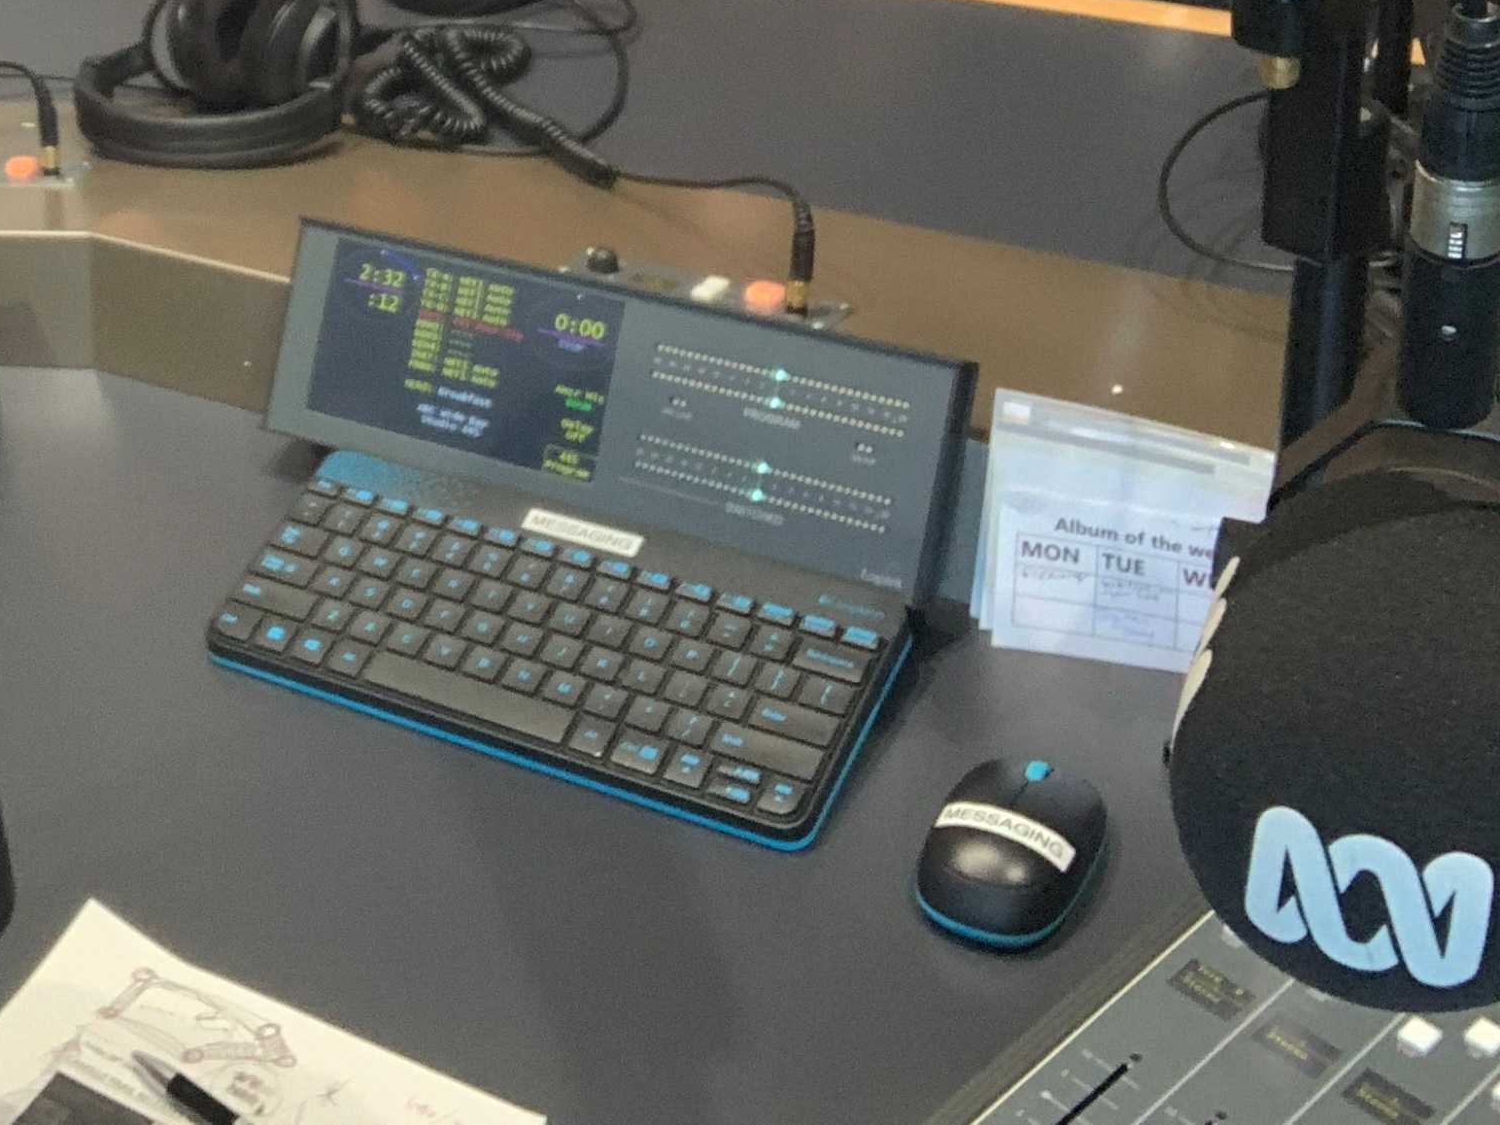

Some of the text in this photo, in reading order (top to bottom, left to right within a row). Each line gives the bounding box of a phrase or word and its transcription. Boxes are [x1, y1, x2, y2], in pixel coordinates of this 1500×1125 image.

[359, 263, 406, 288] 2:32
[554, 313, 607, 340] 0:00
[1054, 516, 1120, 542] Album
[1124, 531, 1146, 546] of
[1150, 534, 1183, 553] the
[1020, 540, 1081, 564] MON
[1102, 552, 1147, 576] TUE
[943, 807, 1064, 858] MESSAGING
